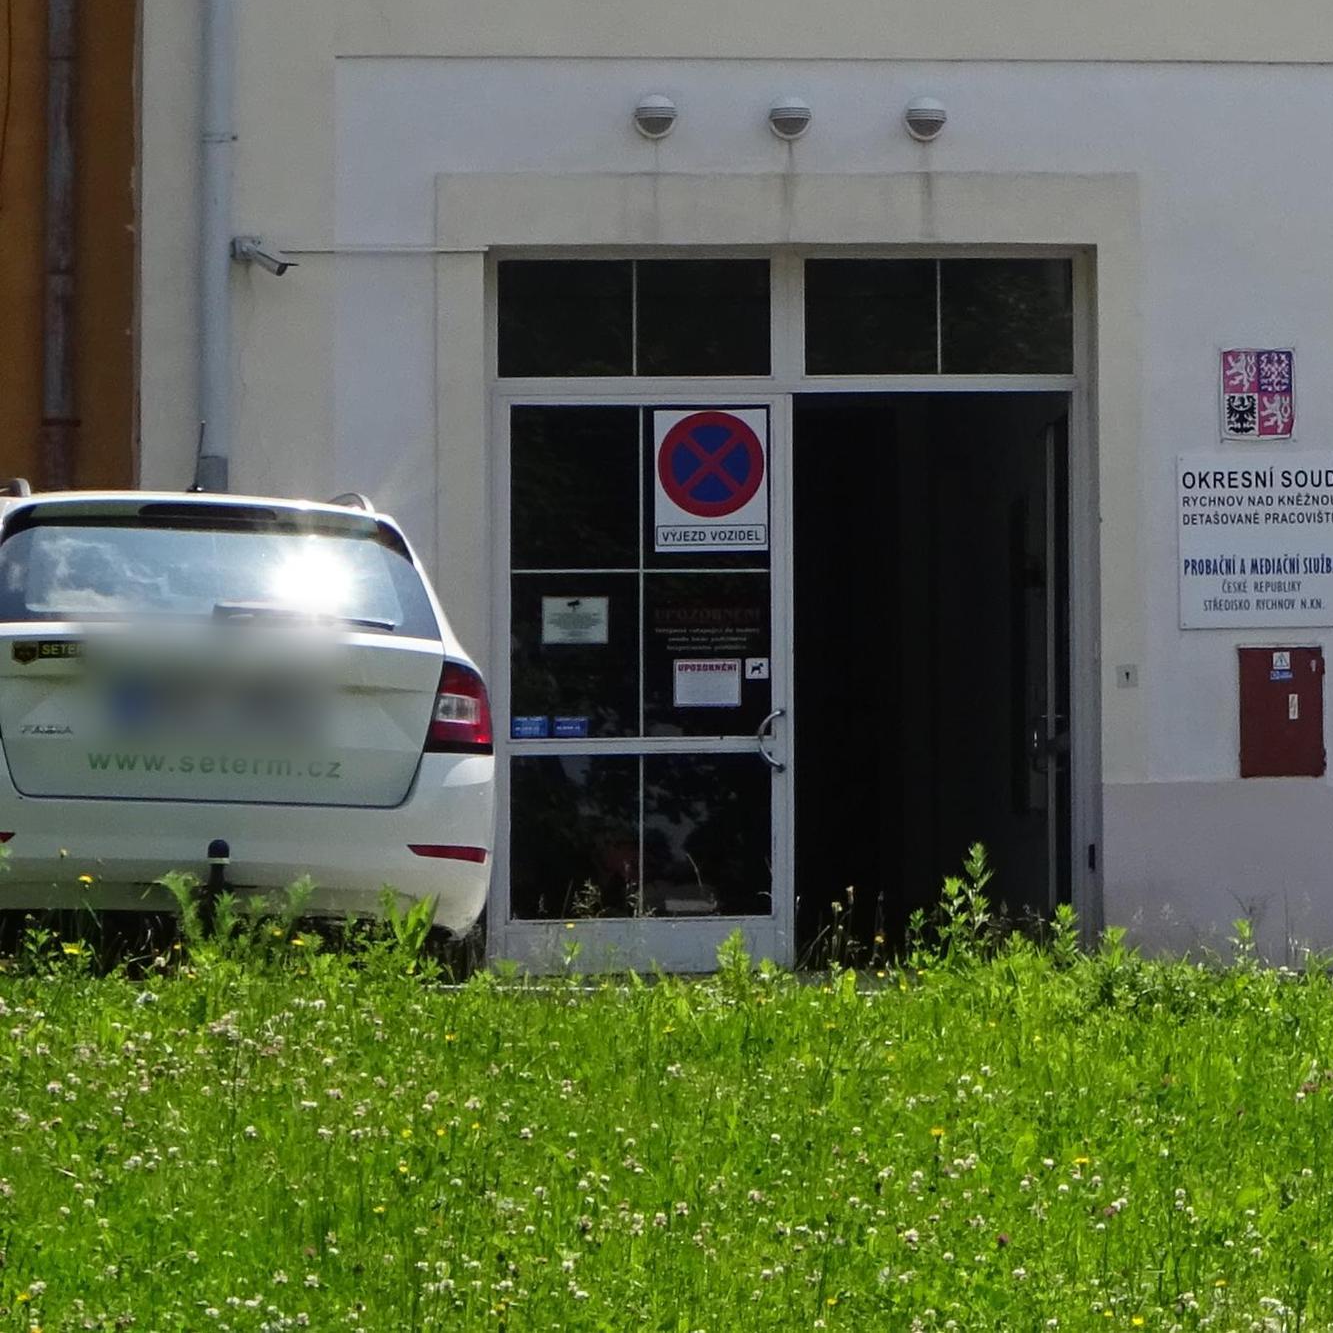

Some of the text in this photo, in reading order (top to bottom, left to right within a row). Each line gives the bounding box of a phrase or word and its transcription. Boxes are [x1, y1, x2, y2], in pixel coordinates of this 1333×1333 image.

[1182, 466, 1274, 489] OKRESNÍ
[1182, 495, 1244, 507] RYCHNOV
[1247, 495, 1274, 506] NAD
[662, 529, 761, 542] VÝJEZD VOZIDEL
[1184, 554, 1236, 575] PROBAČNÍ
[1239, 558, 1246, 575] A
[1250, 553, 1299, 575] MEDIAČNÍ
[1221, 579, 1302, 593] ČESKÉ REPUBLIKY
[1203, 596, 1250, 611] STŘEDISKO
[1255, 598, 1296, 610] RYCHNOV
[87, 752, 342, 779] www.seterm.cz
